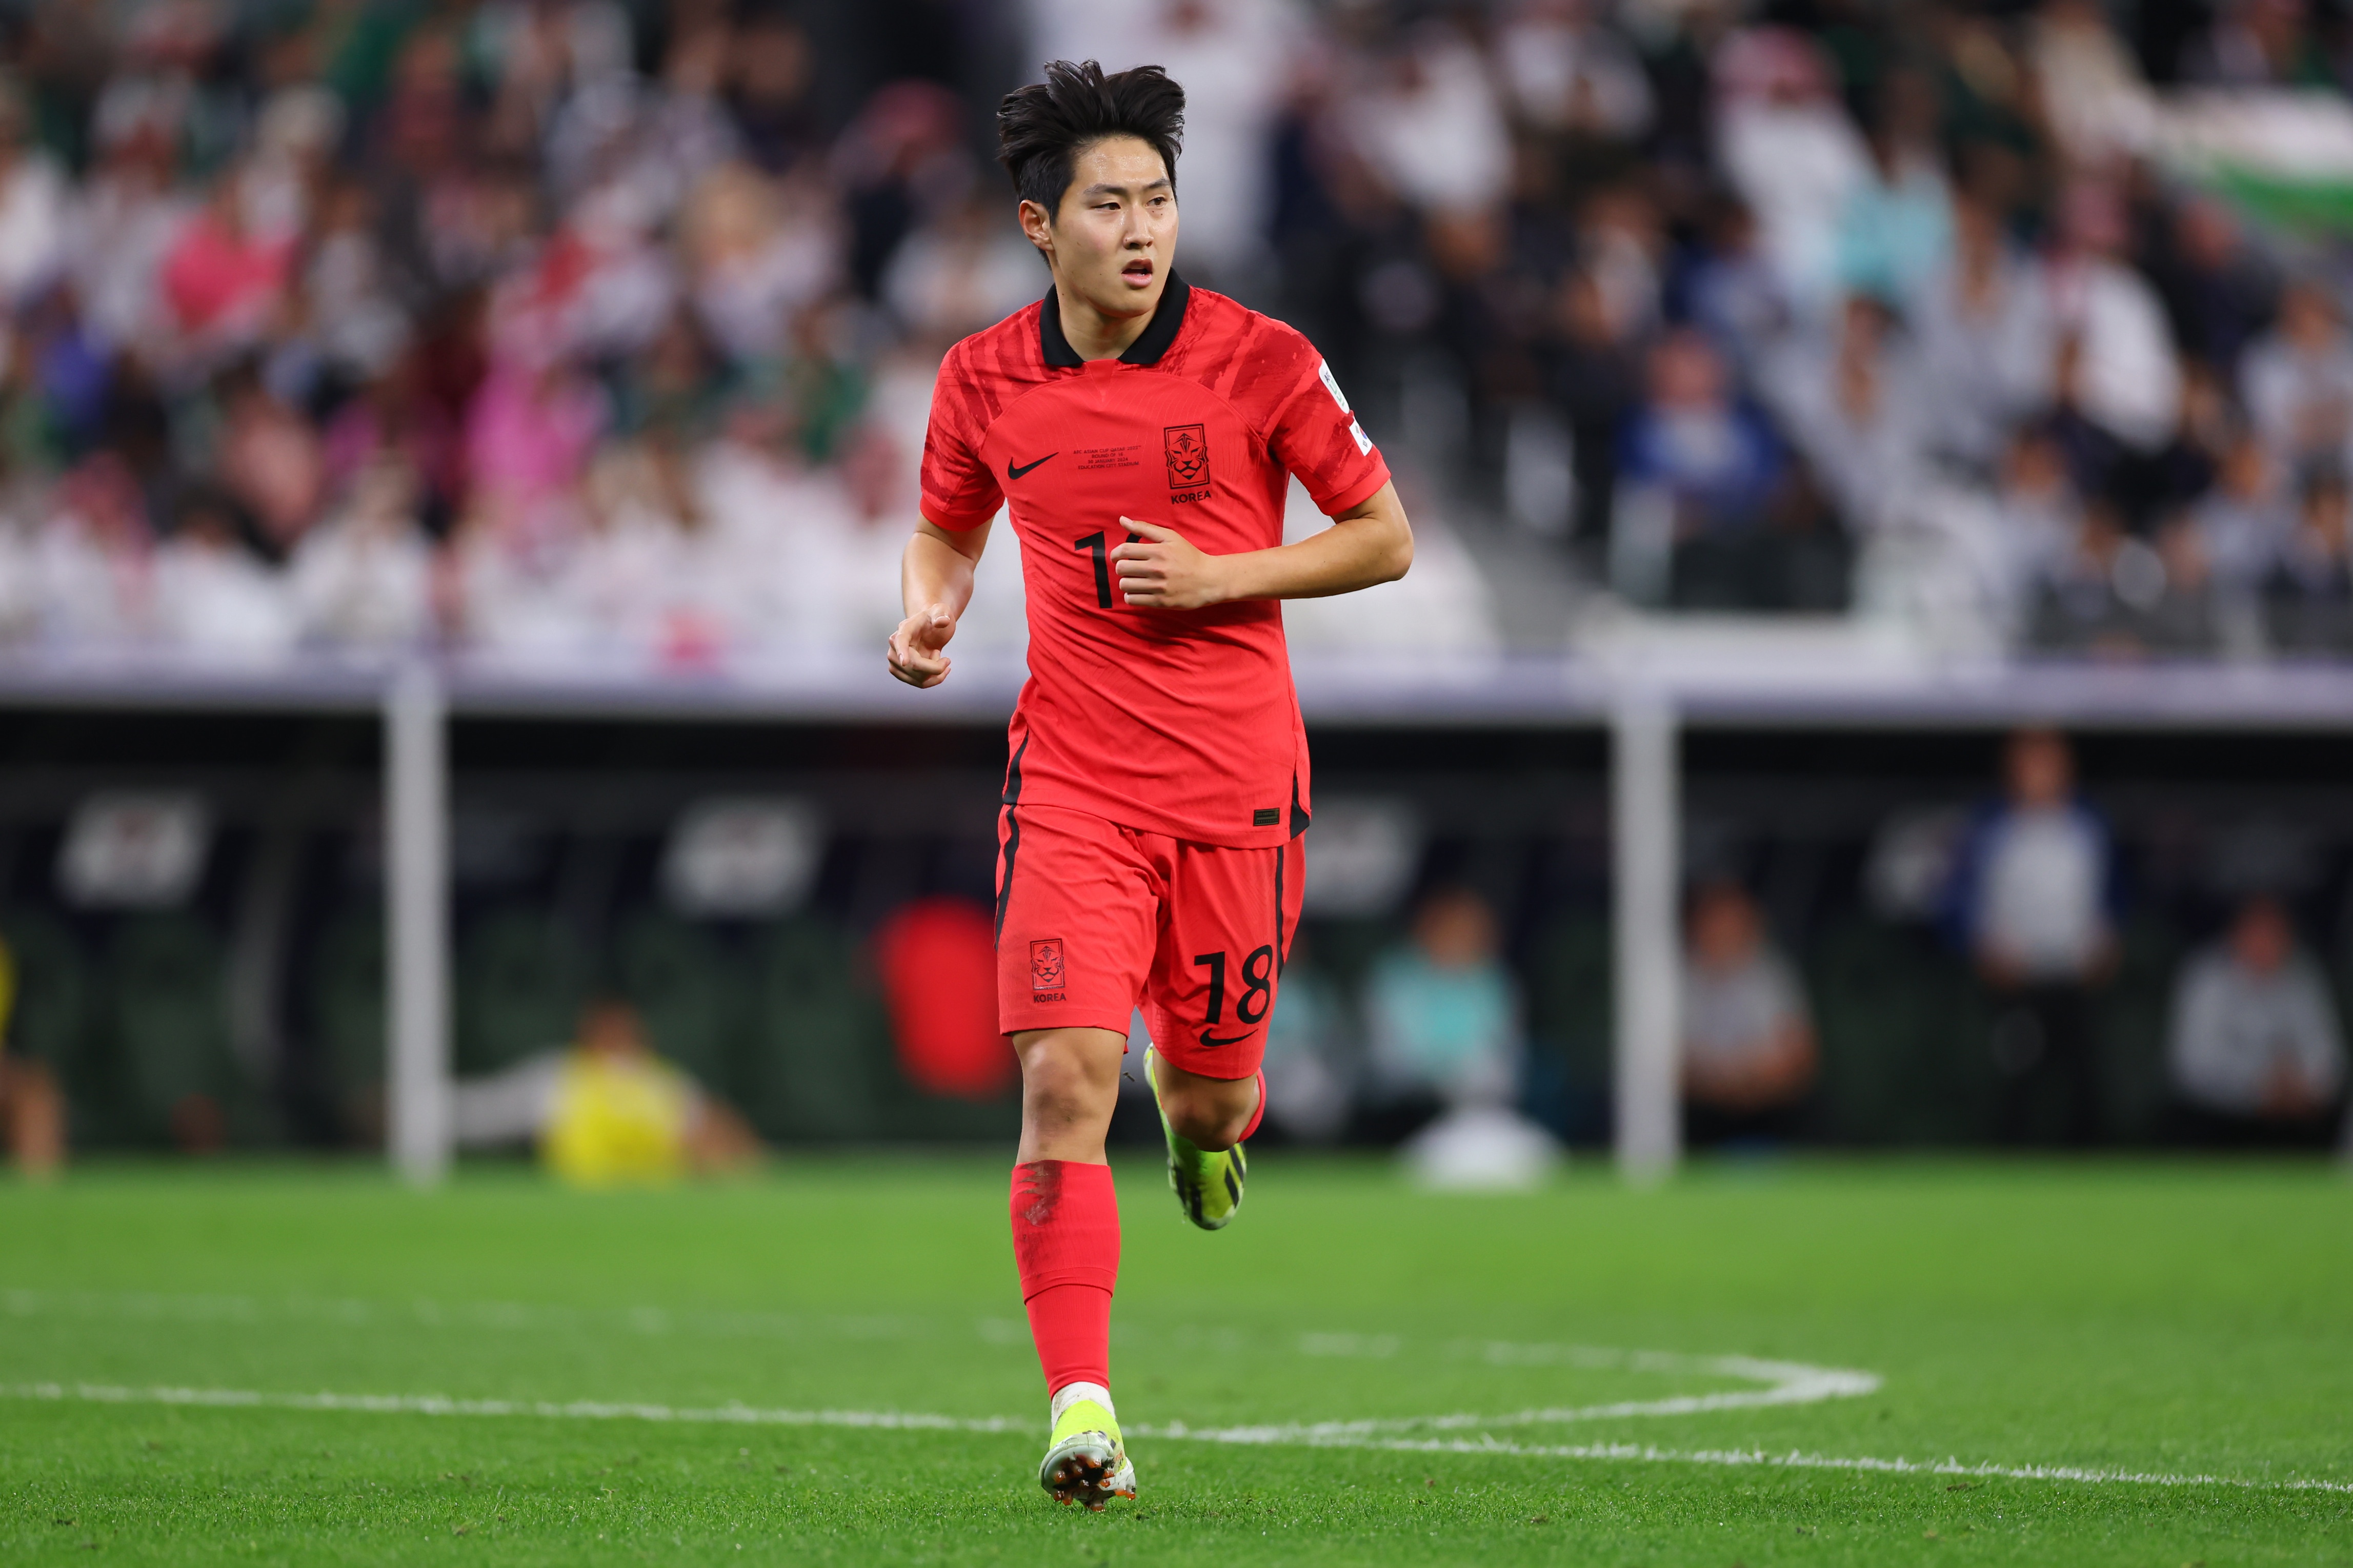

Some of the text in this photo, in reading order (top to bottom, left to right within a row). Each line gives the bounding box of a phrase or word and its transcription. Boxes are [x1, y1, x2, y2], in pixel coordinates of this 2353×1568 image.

[1171, 490, 1212, 504] KOREA
[1194, 944, 1273, 1025] 18
[1033, 993, 1067, 1003] KOREA
